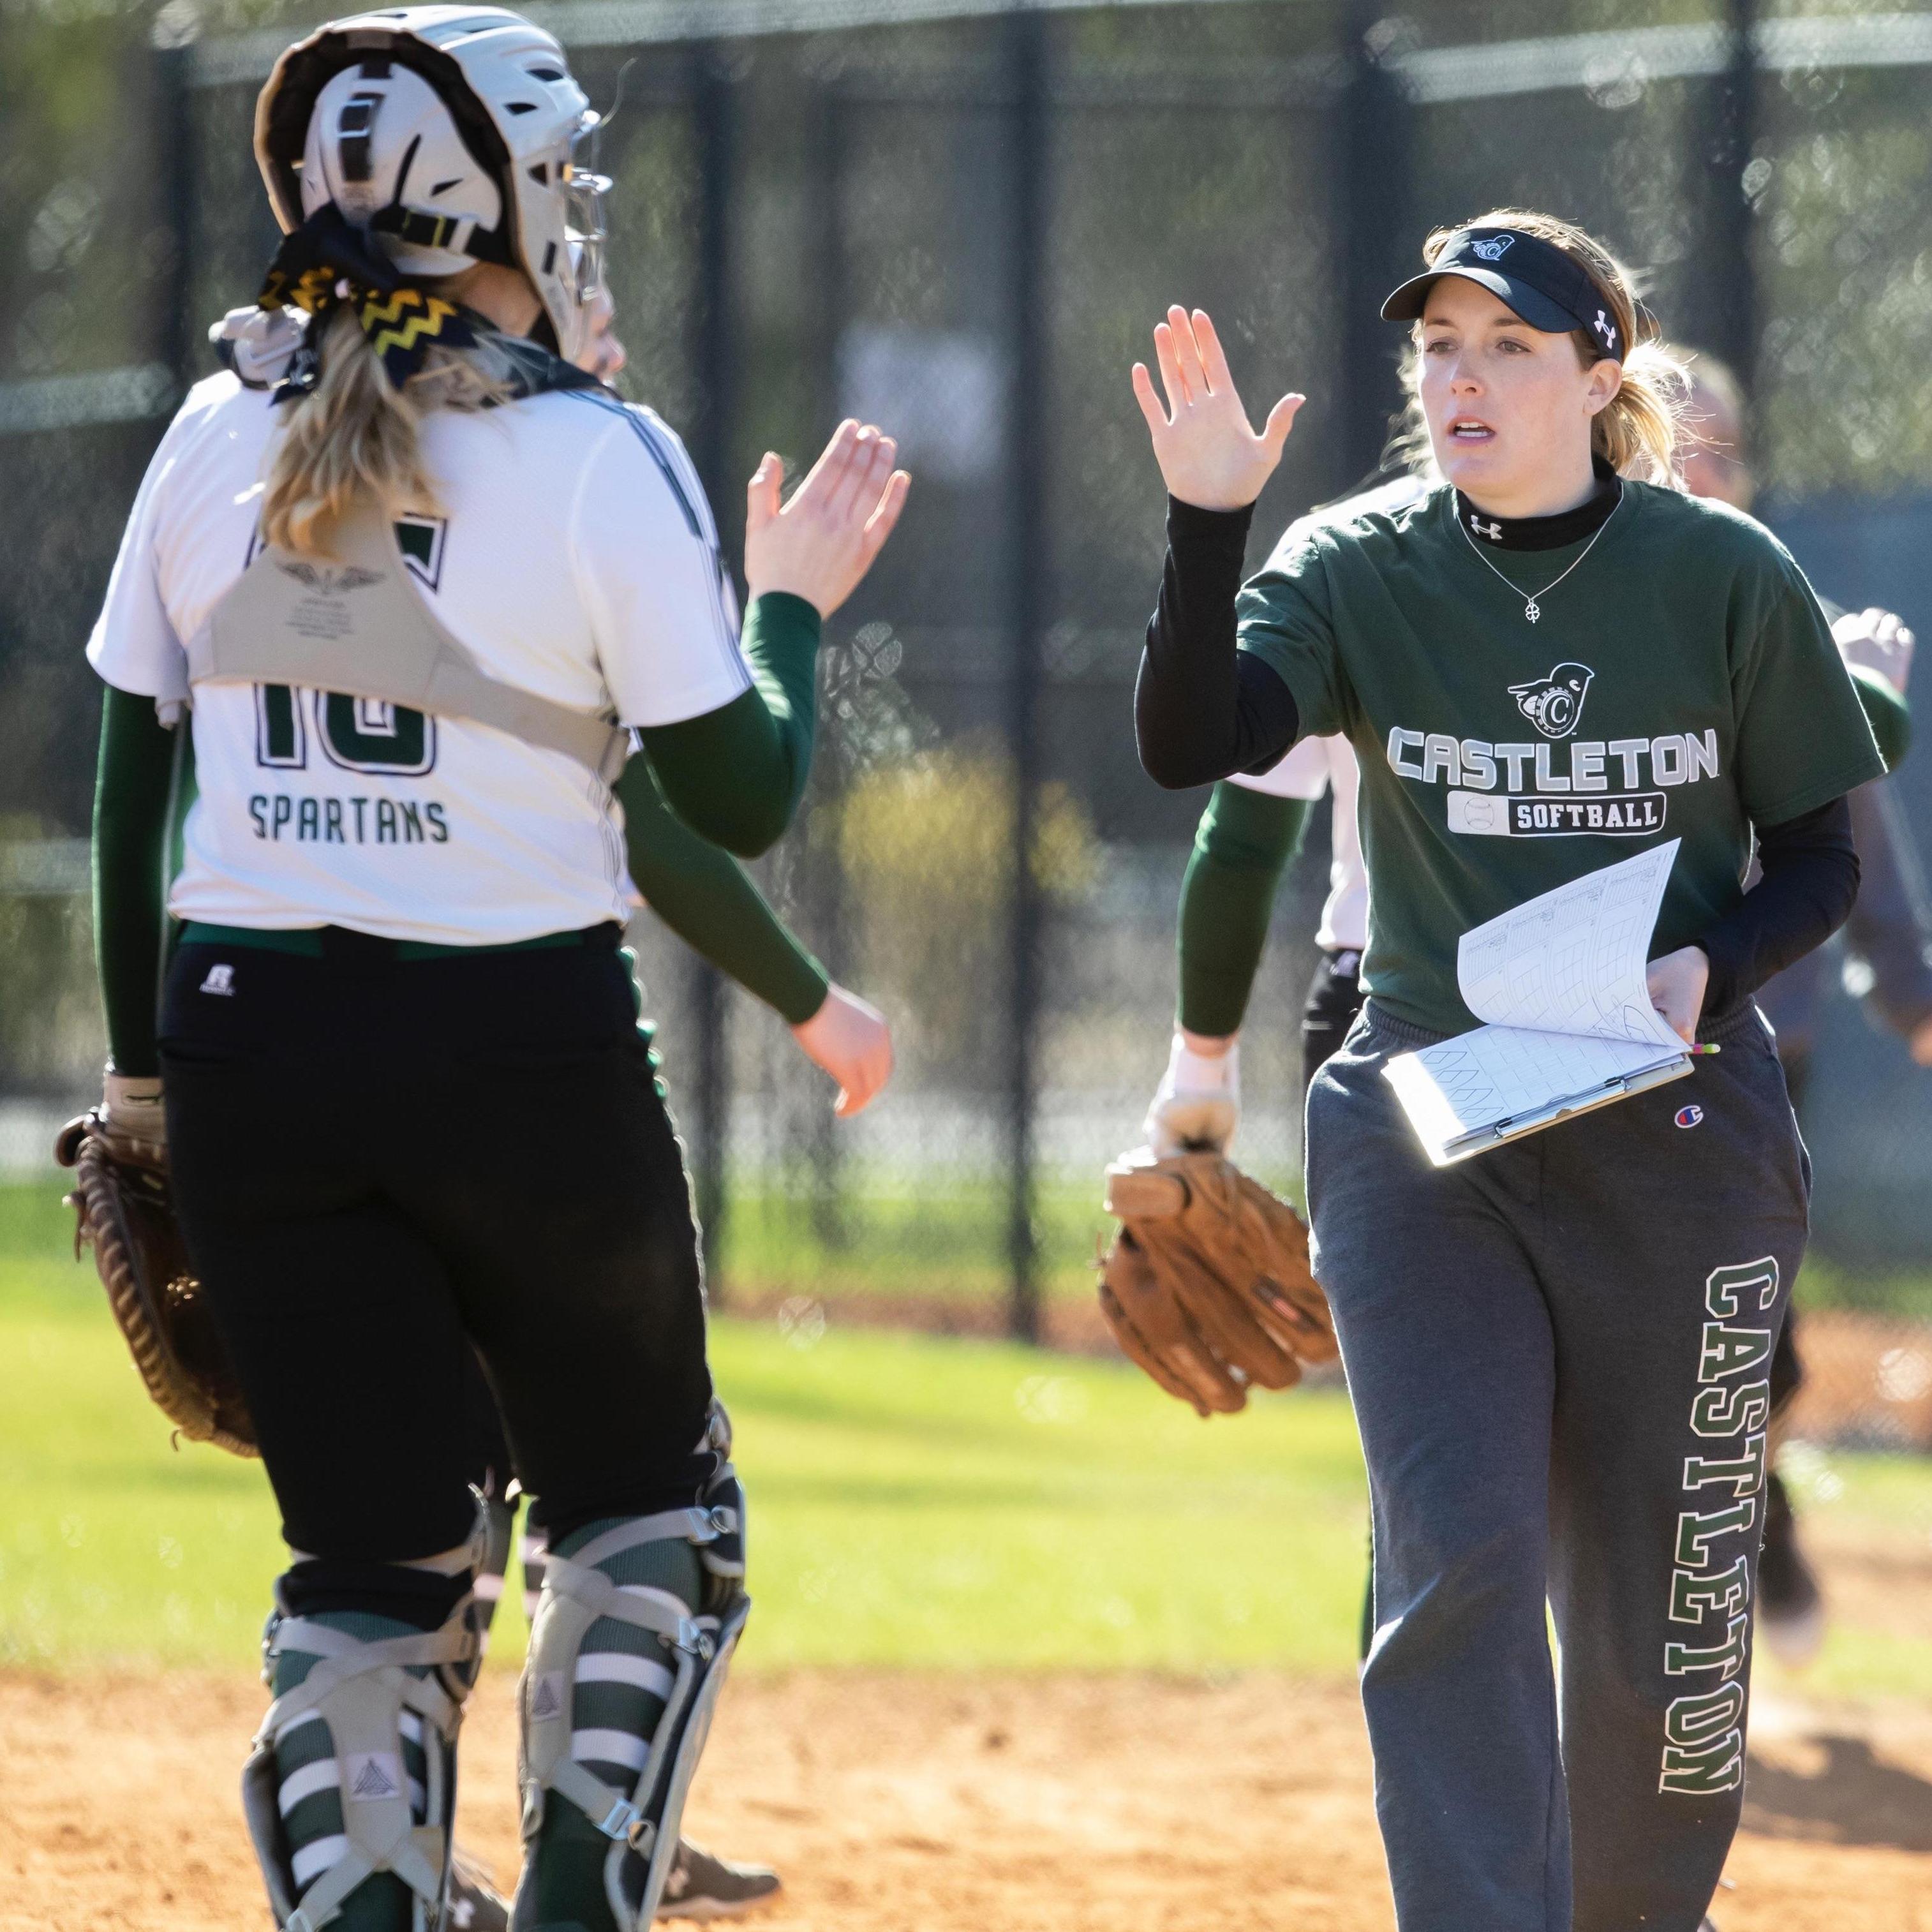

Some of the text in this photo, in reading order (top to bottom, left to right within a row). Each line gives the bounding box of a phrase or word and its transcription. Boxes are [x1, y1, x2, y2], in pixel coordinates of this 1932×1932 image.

[1550, 696, 1570, 724] C
[1387, 726, 1718, 792] CASTLETON
[248, 794, 449, 845] SPARTANS
[1517, 801, 1658, 829] SOFTBALL
[1659, 1256, 1779, 1795] CASTLETON
